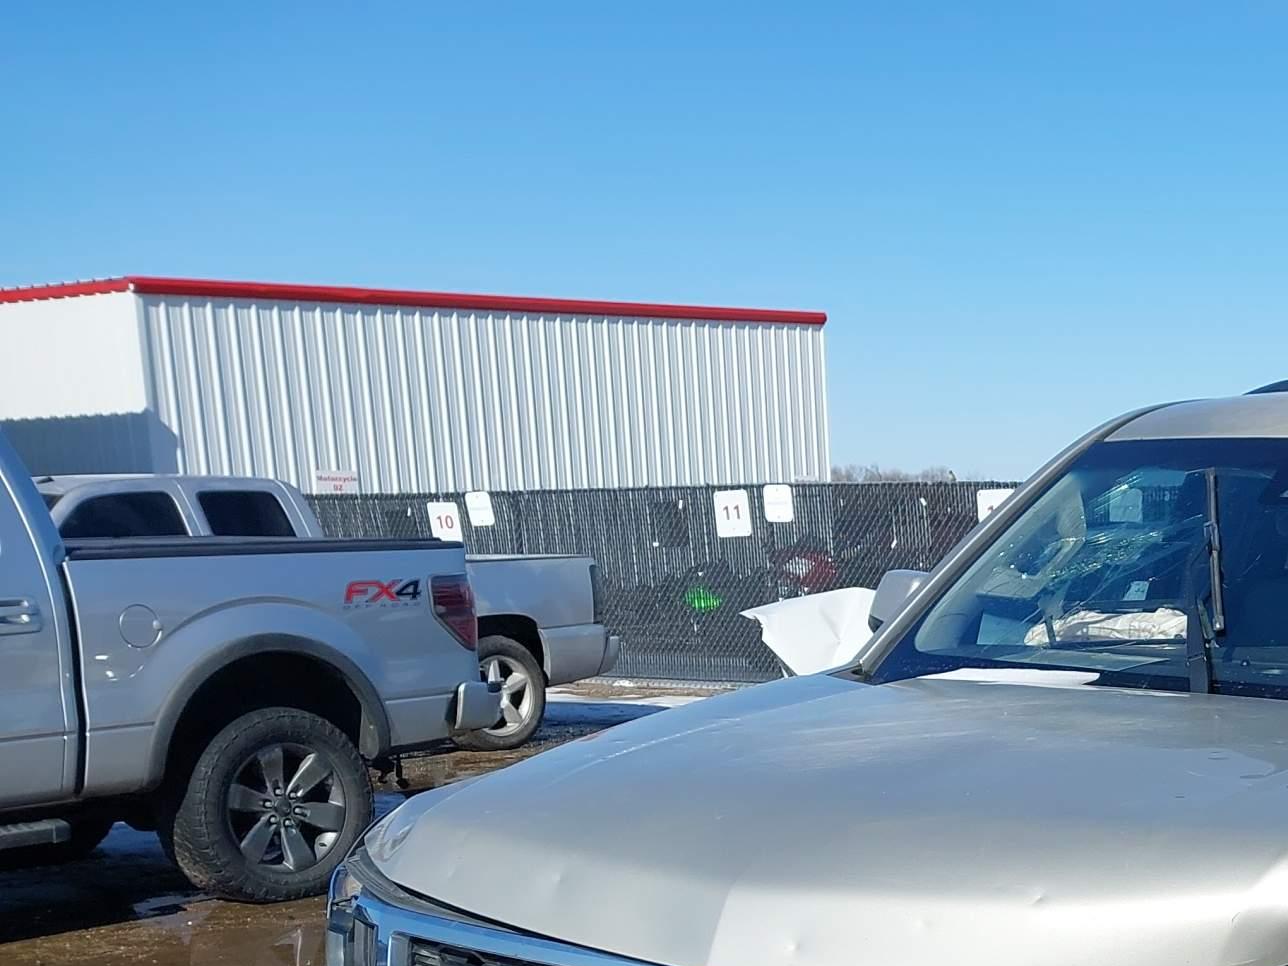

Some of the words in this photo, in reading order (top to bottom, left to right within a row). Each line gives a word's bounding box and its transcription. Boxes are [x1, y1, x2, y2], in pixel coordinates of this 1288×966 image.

[722, 504, 741, 521] 11
[436, 514, 454, 529] 10
[344, 579, 421, 604] FX4
